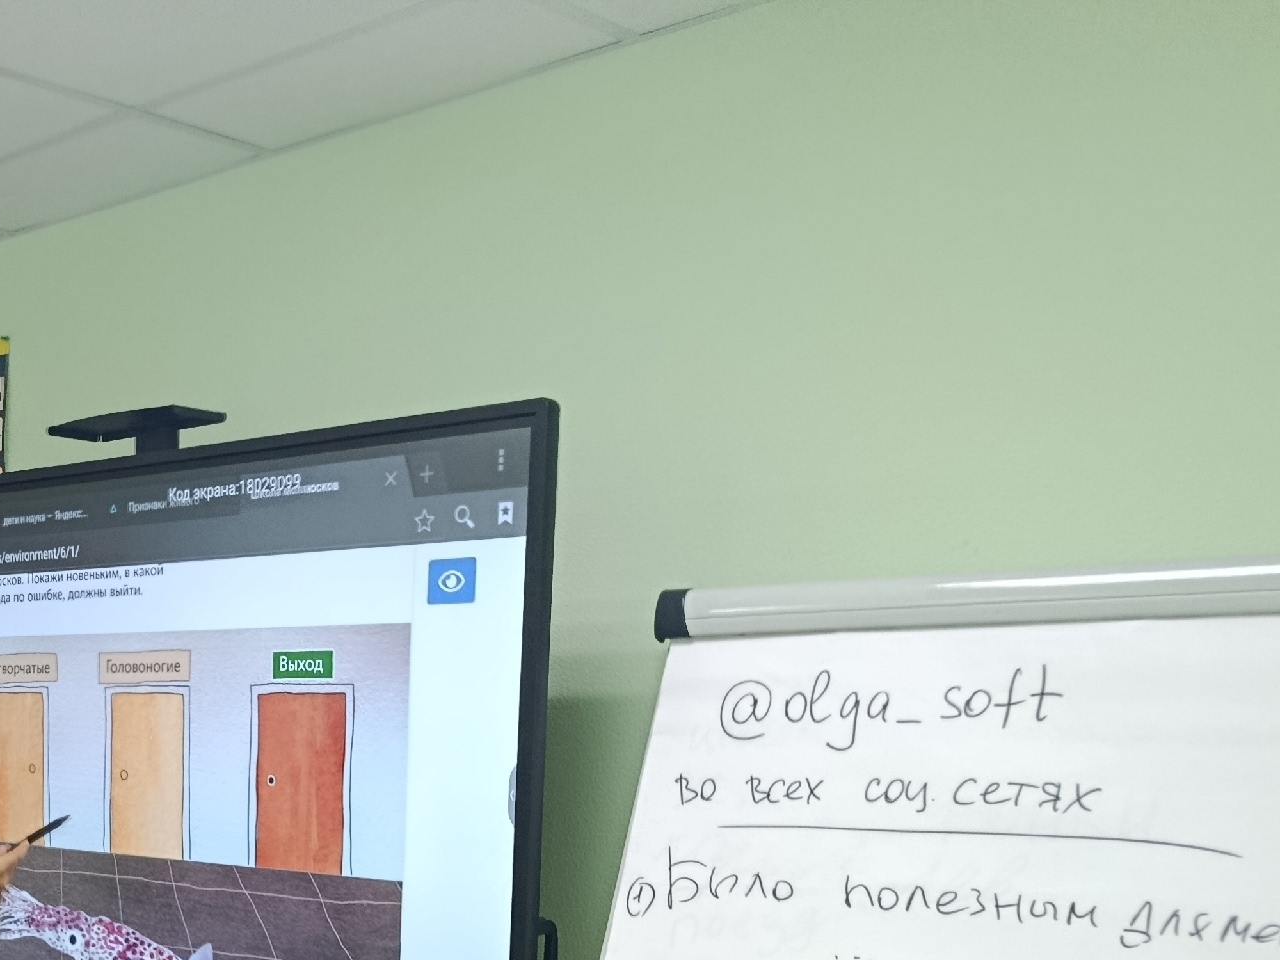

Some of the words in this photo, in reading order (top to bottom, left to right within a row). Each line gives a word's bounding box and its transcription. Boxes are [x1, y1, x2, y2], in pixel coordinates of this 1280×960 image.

[169, 486, 190, 501] Код
[27, 572, 63, 584] Покажи
[67, 569, 122, 581] новеньким,
[125, 569, 130, 578] в
[13, 593, 24, 602] по
[27, 588, 65, 603] ошибке,
[67, 588, 107, 601] должны
[110, 584, 143, 597] выйти.
[106, 659, 181, 674] Головоногие
[279, 655, 324, 674] Выход
[676, 772, 717, 807] во
[749, 773, 824, 806] всех
[953, 778, 1102, 813] сетях
[845, 873, 1098, 929] полезным
